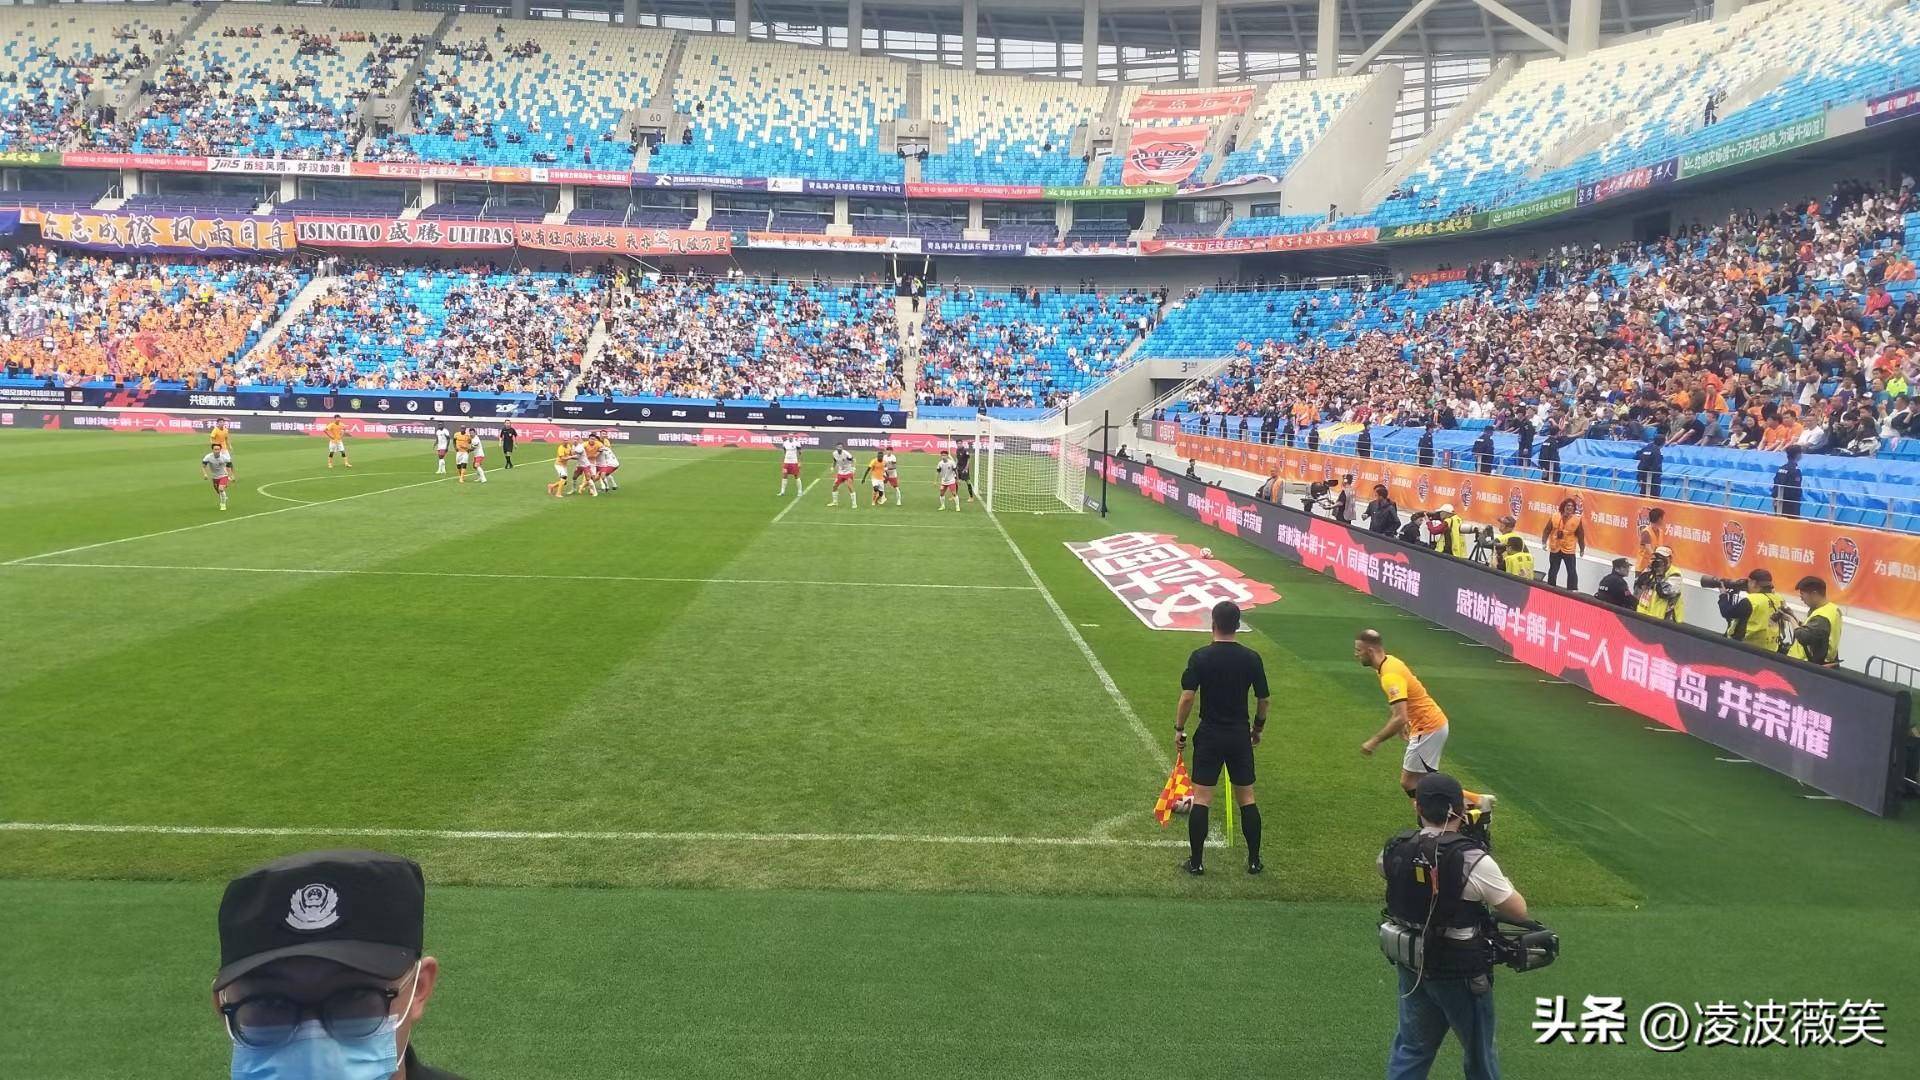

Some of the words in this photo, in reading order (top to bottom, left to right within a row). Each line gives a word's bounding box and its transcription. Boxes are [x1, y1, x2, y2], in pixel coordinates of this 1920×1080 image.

[384, 103, 397, 113] 59
[648, 113, 662, 123] 60
[907, 124, 920, 133] 61
[1098, 127, 1111, 136] 62
[42, 211, 160, 248] 众志成橙
[170, 216, 288, 252] 风雨同舟
[297, 222, 381, 241] TSINGTAO
[448, 225, 513, 244] ULTRAS
[1277, 523, 1345, 568] 感谢海牛第十二人
[1347, 546, 1380, 581] 同青岛
[1382, 560, 1421, 599] 共荣耀
[1756, 541, 1815, 566] 为青岛而战
[1455, 588, 1614, 676] 感谢海牛第十二人
[1621, 645, 1709, 713] 同青岛
[1718, 680, 1833, 760] 共荣耀
